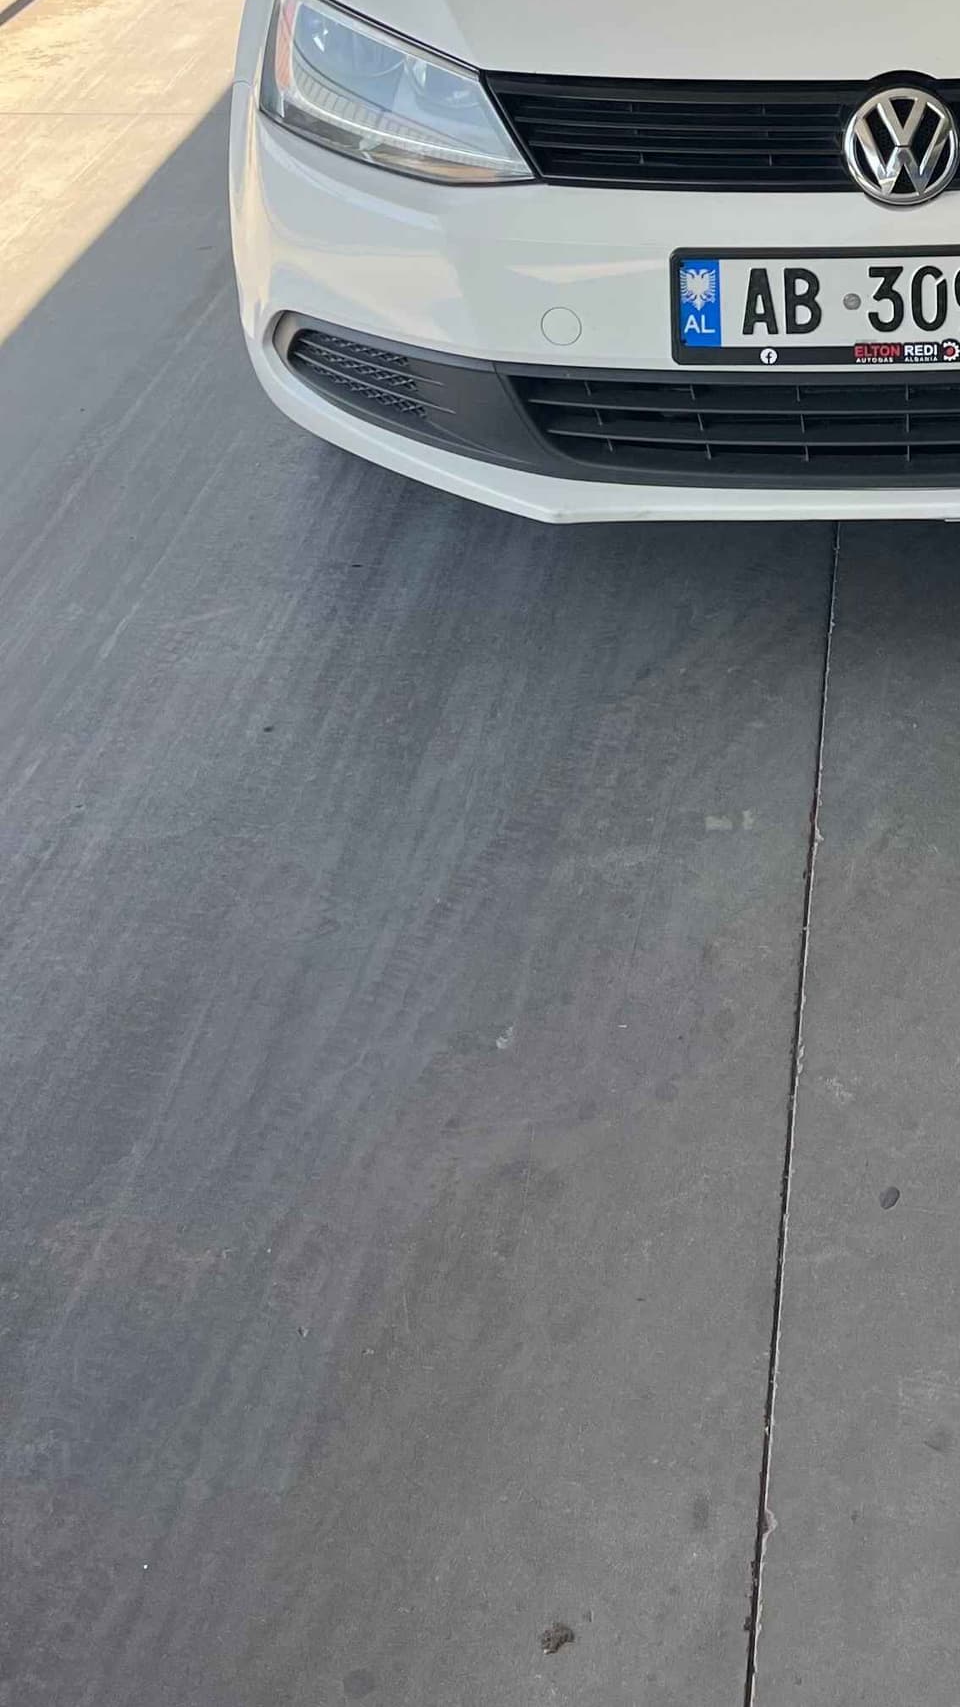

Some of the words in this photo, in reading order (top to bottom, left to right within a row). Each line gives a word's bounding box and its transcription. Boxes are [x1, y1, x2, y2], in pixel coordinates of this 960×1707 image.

[742, 267, 822, 335] AB
[684, 314, 716, 334] AL
[854, 344, 900, 357] ELTON
[904, 344, 938, 356] REDI
